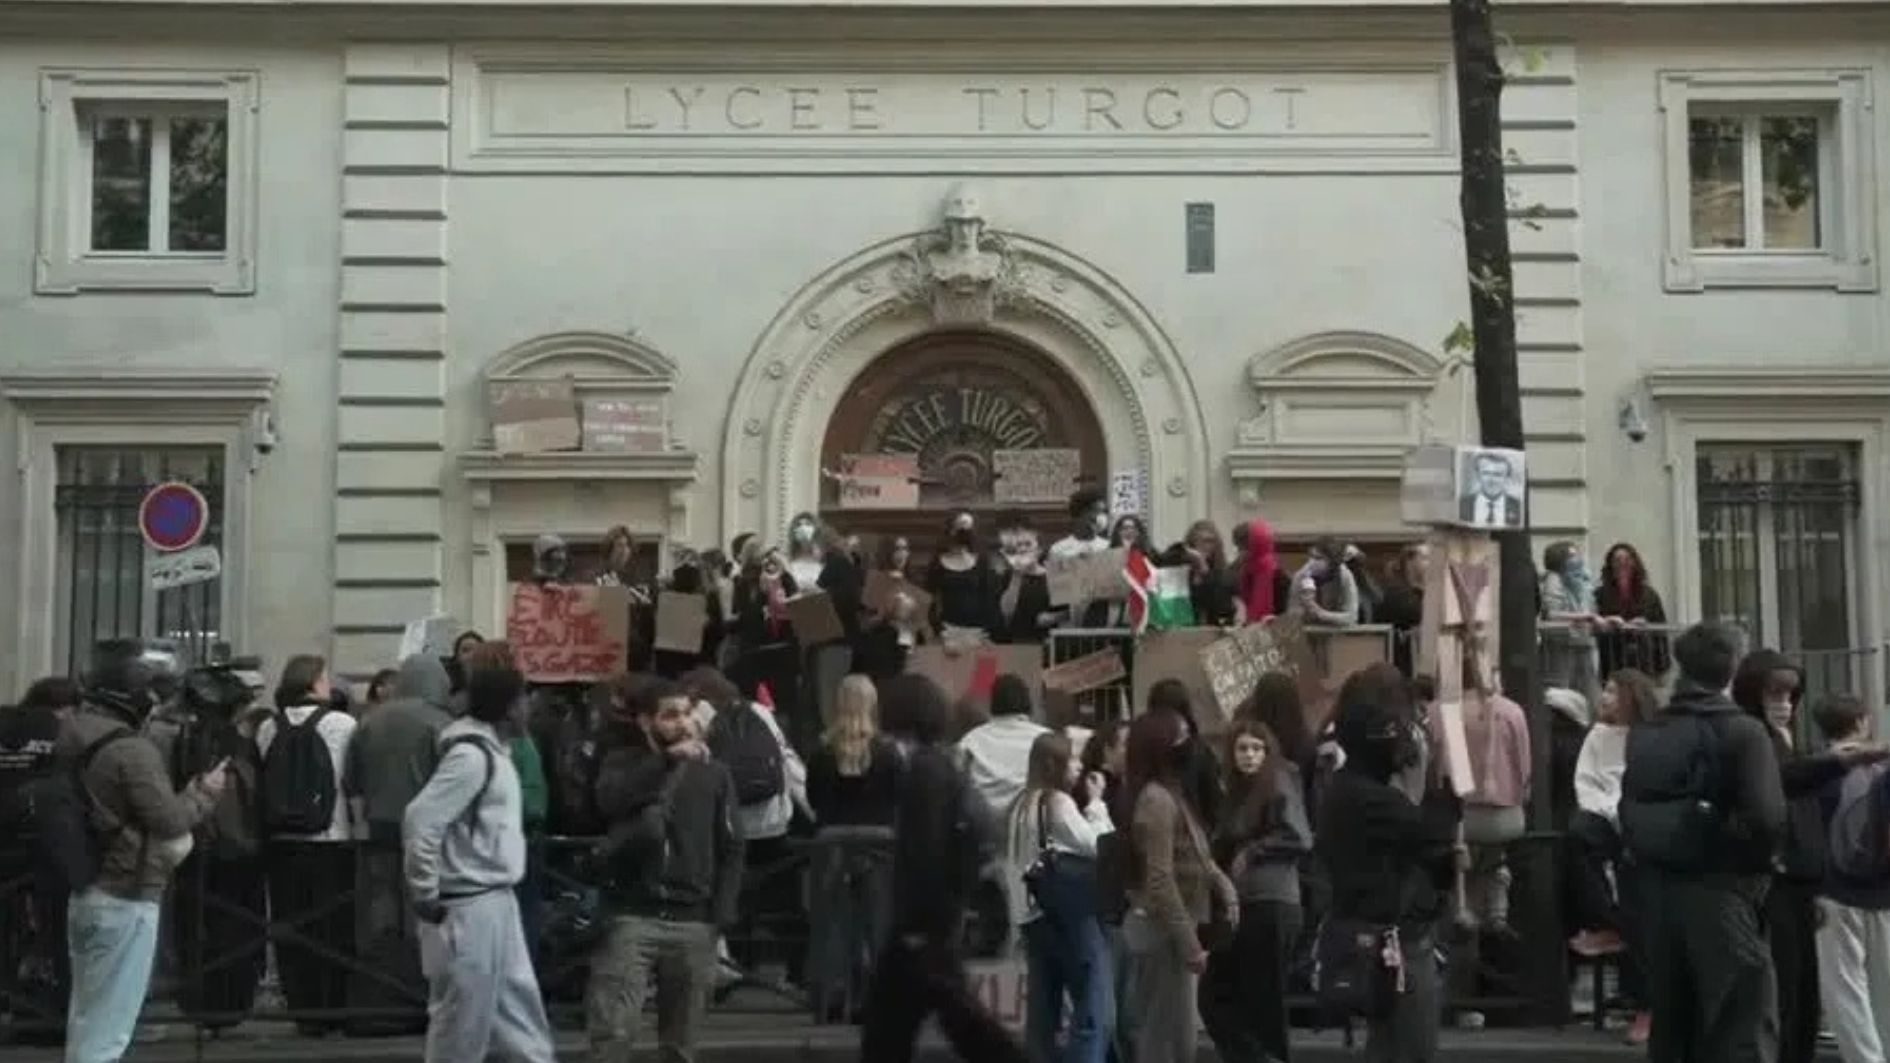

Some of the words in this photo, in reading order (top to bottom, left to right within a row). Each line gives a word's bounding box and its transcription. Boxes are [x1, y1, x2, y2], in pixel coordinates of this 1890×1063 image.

[623, 87, 880, 130] LYCEE
[963, 87, 1307, 130] TURGOT
[884, 392, 949, 452] YCEE
[958, 388, 1042, 448] TURGO
